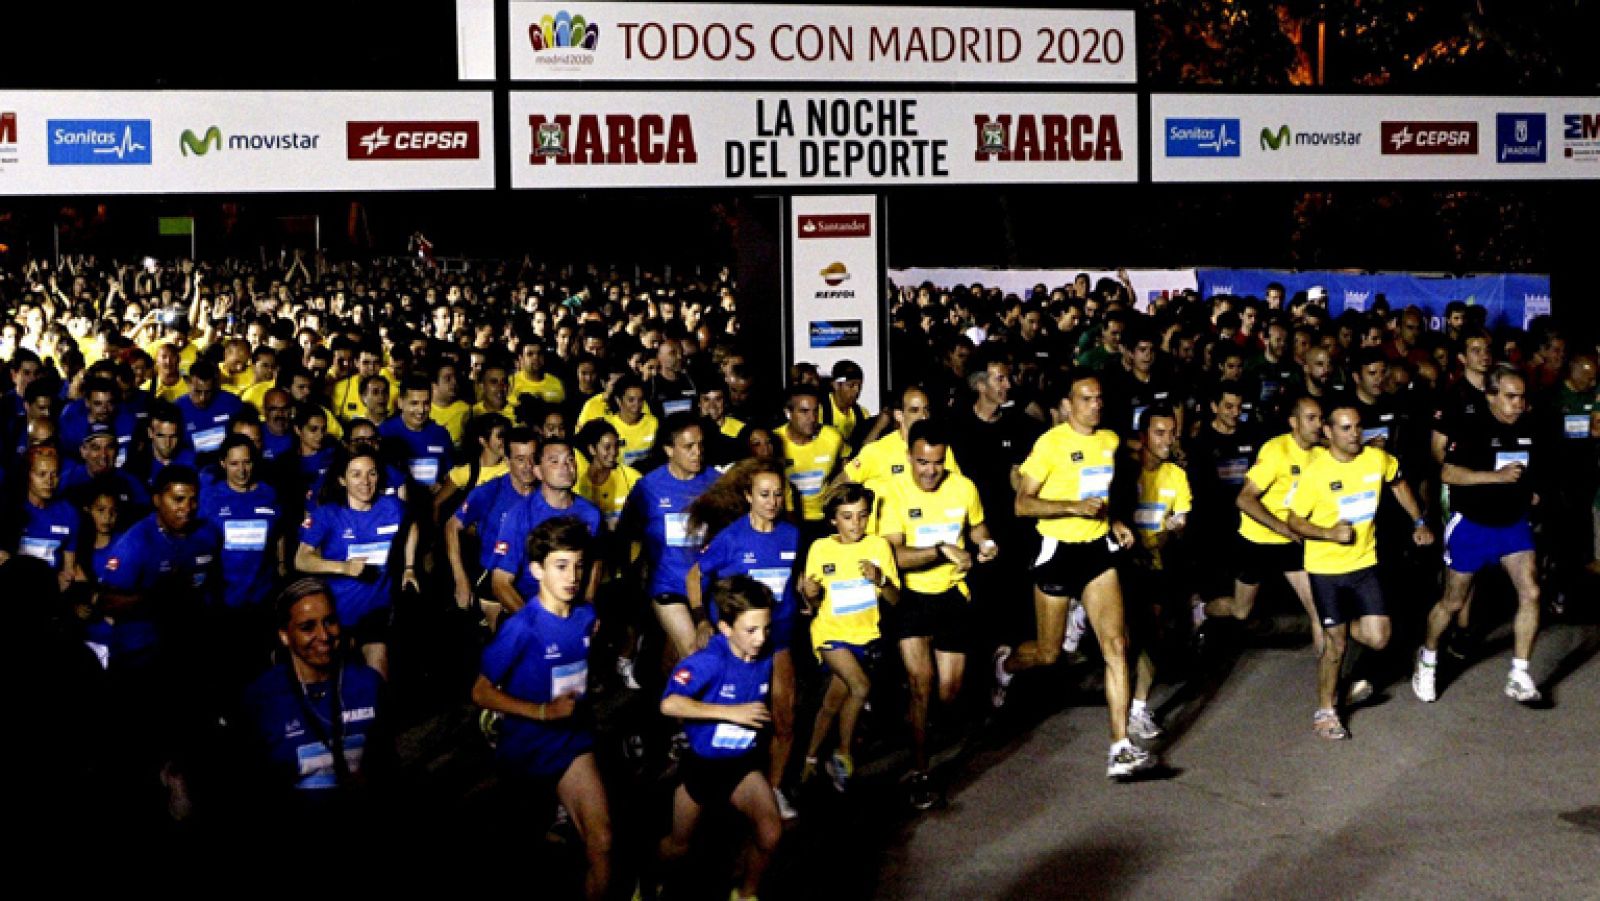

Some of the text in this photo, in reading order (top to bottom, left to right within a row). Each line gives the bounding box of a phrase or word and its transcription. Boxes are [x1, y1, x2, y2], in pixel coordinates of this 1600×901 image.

[617, 22, 1125, 63] TODOS CON MADRID 2020
[535, 53, 594, 65] madrid2020
[756, 98, 918, 137] LA NOCHE
[54, 128, 116, 145] Sanitas
[228, 133, 320, 149] movistar
[394, 131, 468, 150] CEPSA
[528, 114, 698, 165] MARCA
[974, 114, 1123, 162] MARCA
[1170, 127, 1215, 141] Sanitas
[1295, 131, 1362, 146] movistar
[1416, 130, 1470, 147] CEPSA
[725, 139, 949, 178] DEL DEPORTE
[818, 219, 866, 232] Santander
